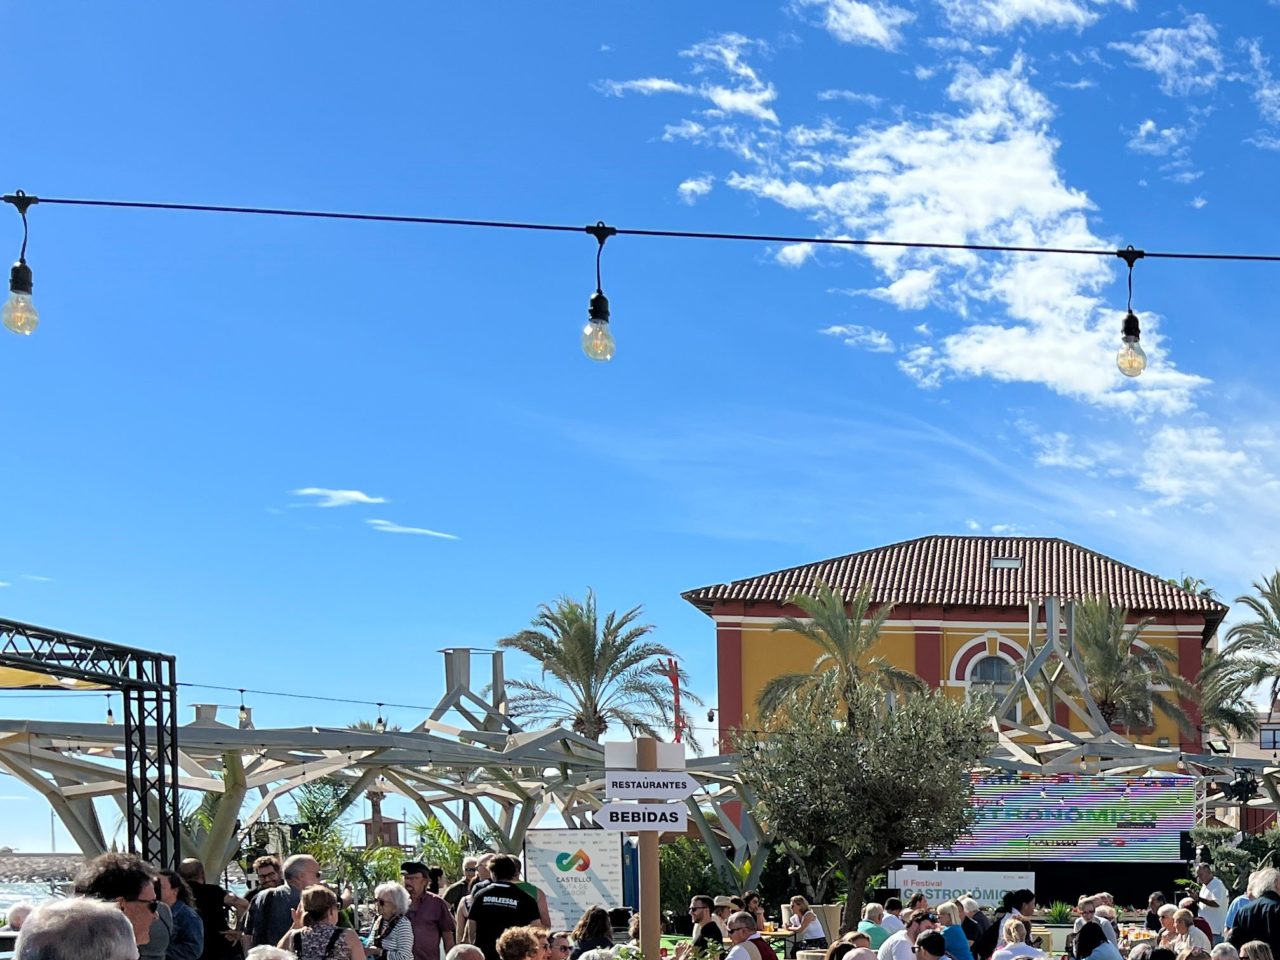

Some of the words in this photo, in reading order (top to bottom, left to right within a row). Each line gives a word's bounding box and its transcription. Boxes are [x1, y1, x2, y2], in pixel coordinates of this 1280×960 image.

[611, 781, 688, 790] RESTAURANTES
[609, 811, 680, 823] BEBIDAS
[910, 879, 943, 887] Festival
